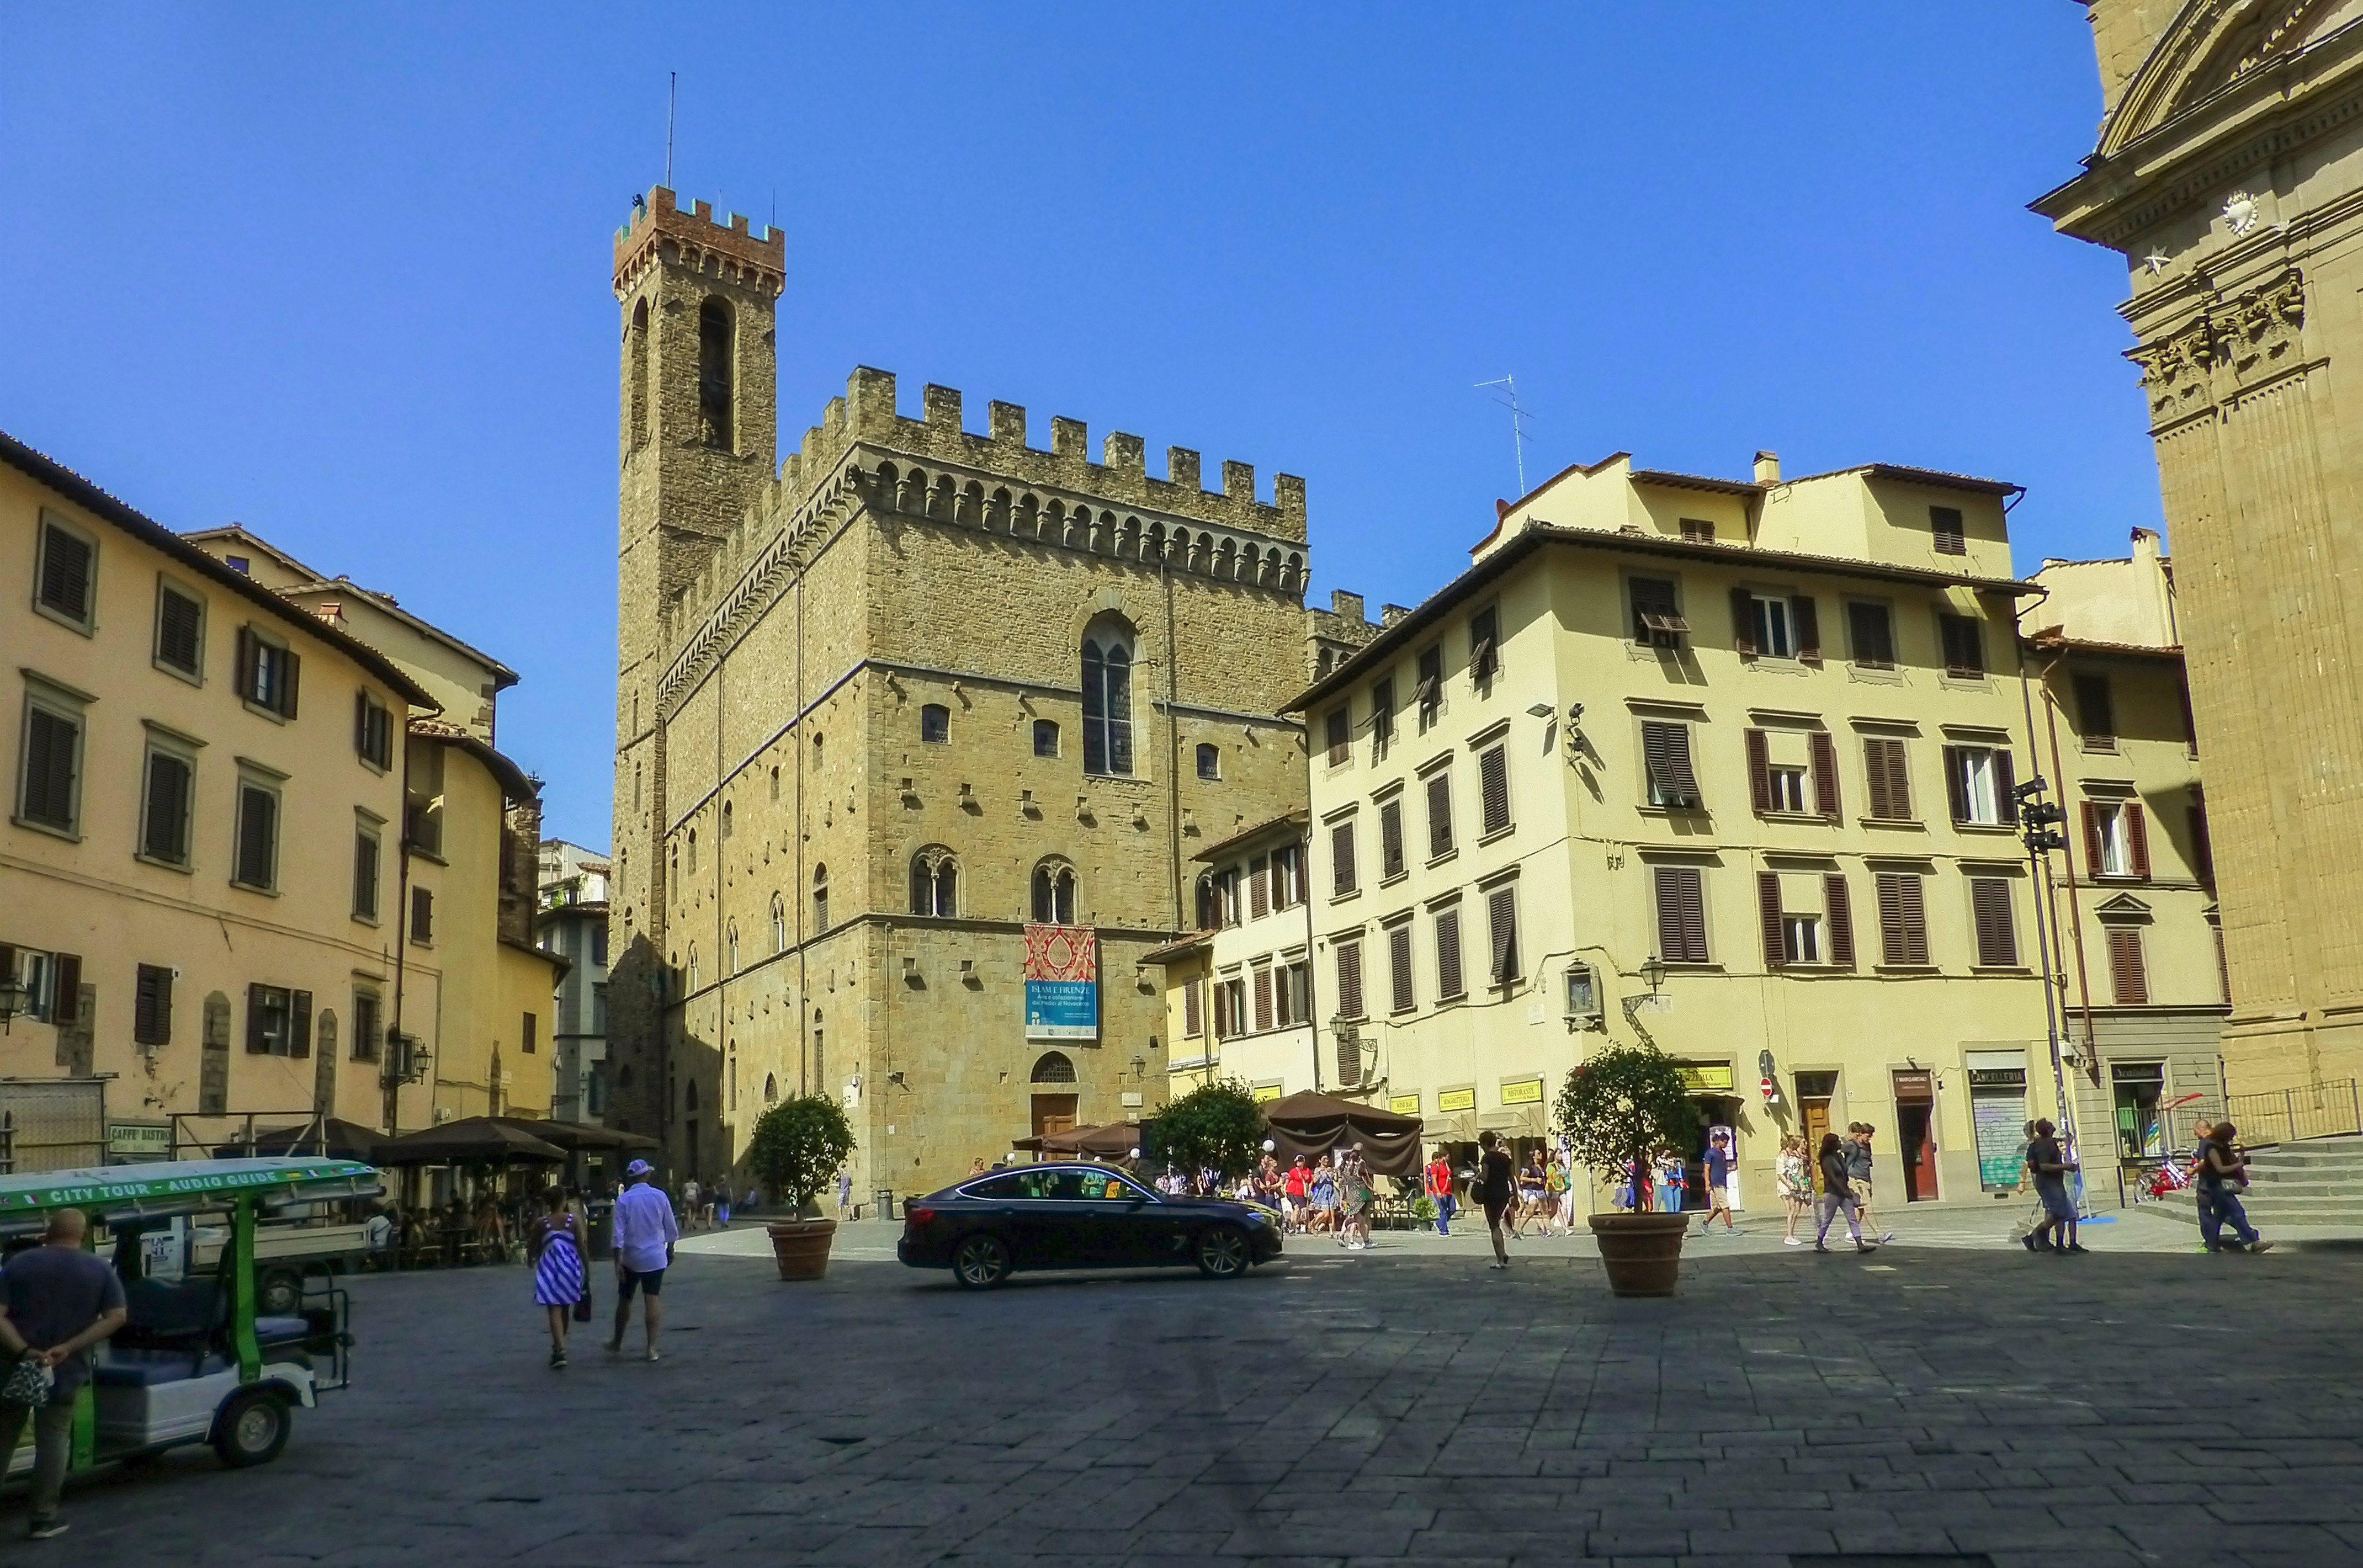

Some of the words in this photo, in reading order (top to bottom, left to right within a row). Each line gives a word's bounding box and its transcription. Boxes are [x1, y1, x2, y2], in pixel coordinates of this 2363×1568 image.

[1031, 985, 1052, 993] ISLAM
[1059, 986, 1091, 995] FIRENZE
[1972, 1072, 2023, 1082] CANCELLERIA
[1507, 1087, 1535, 1097] RISTORANTE
[1443, 1096, 1470, 1105] SPAGHETTERIA
[50, 1188, 93, 1202] CITY
[99, 1183, 150, 1198] TOUR
[169, 1176, 222, 1191] AUDIO
[226, 1171, 278, 1185] GUIDE
